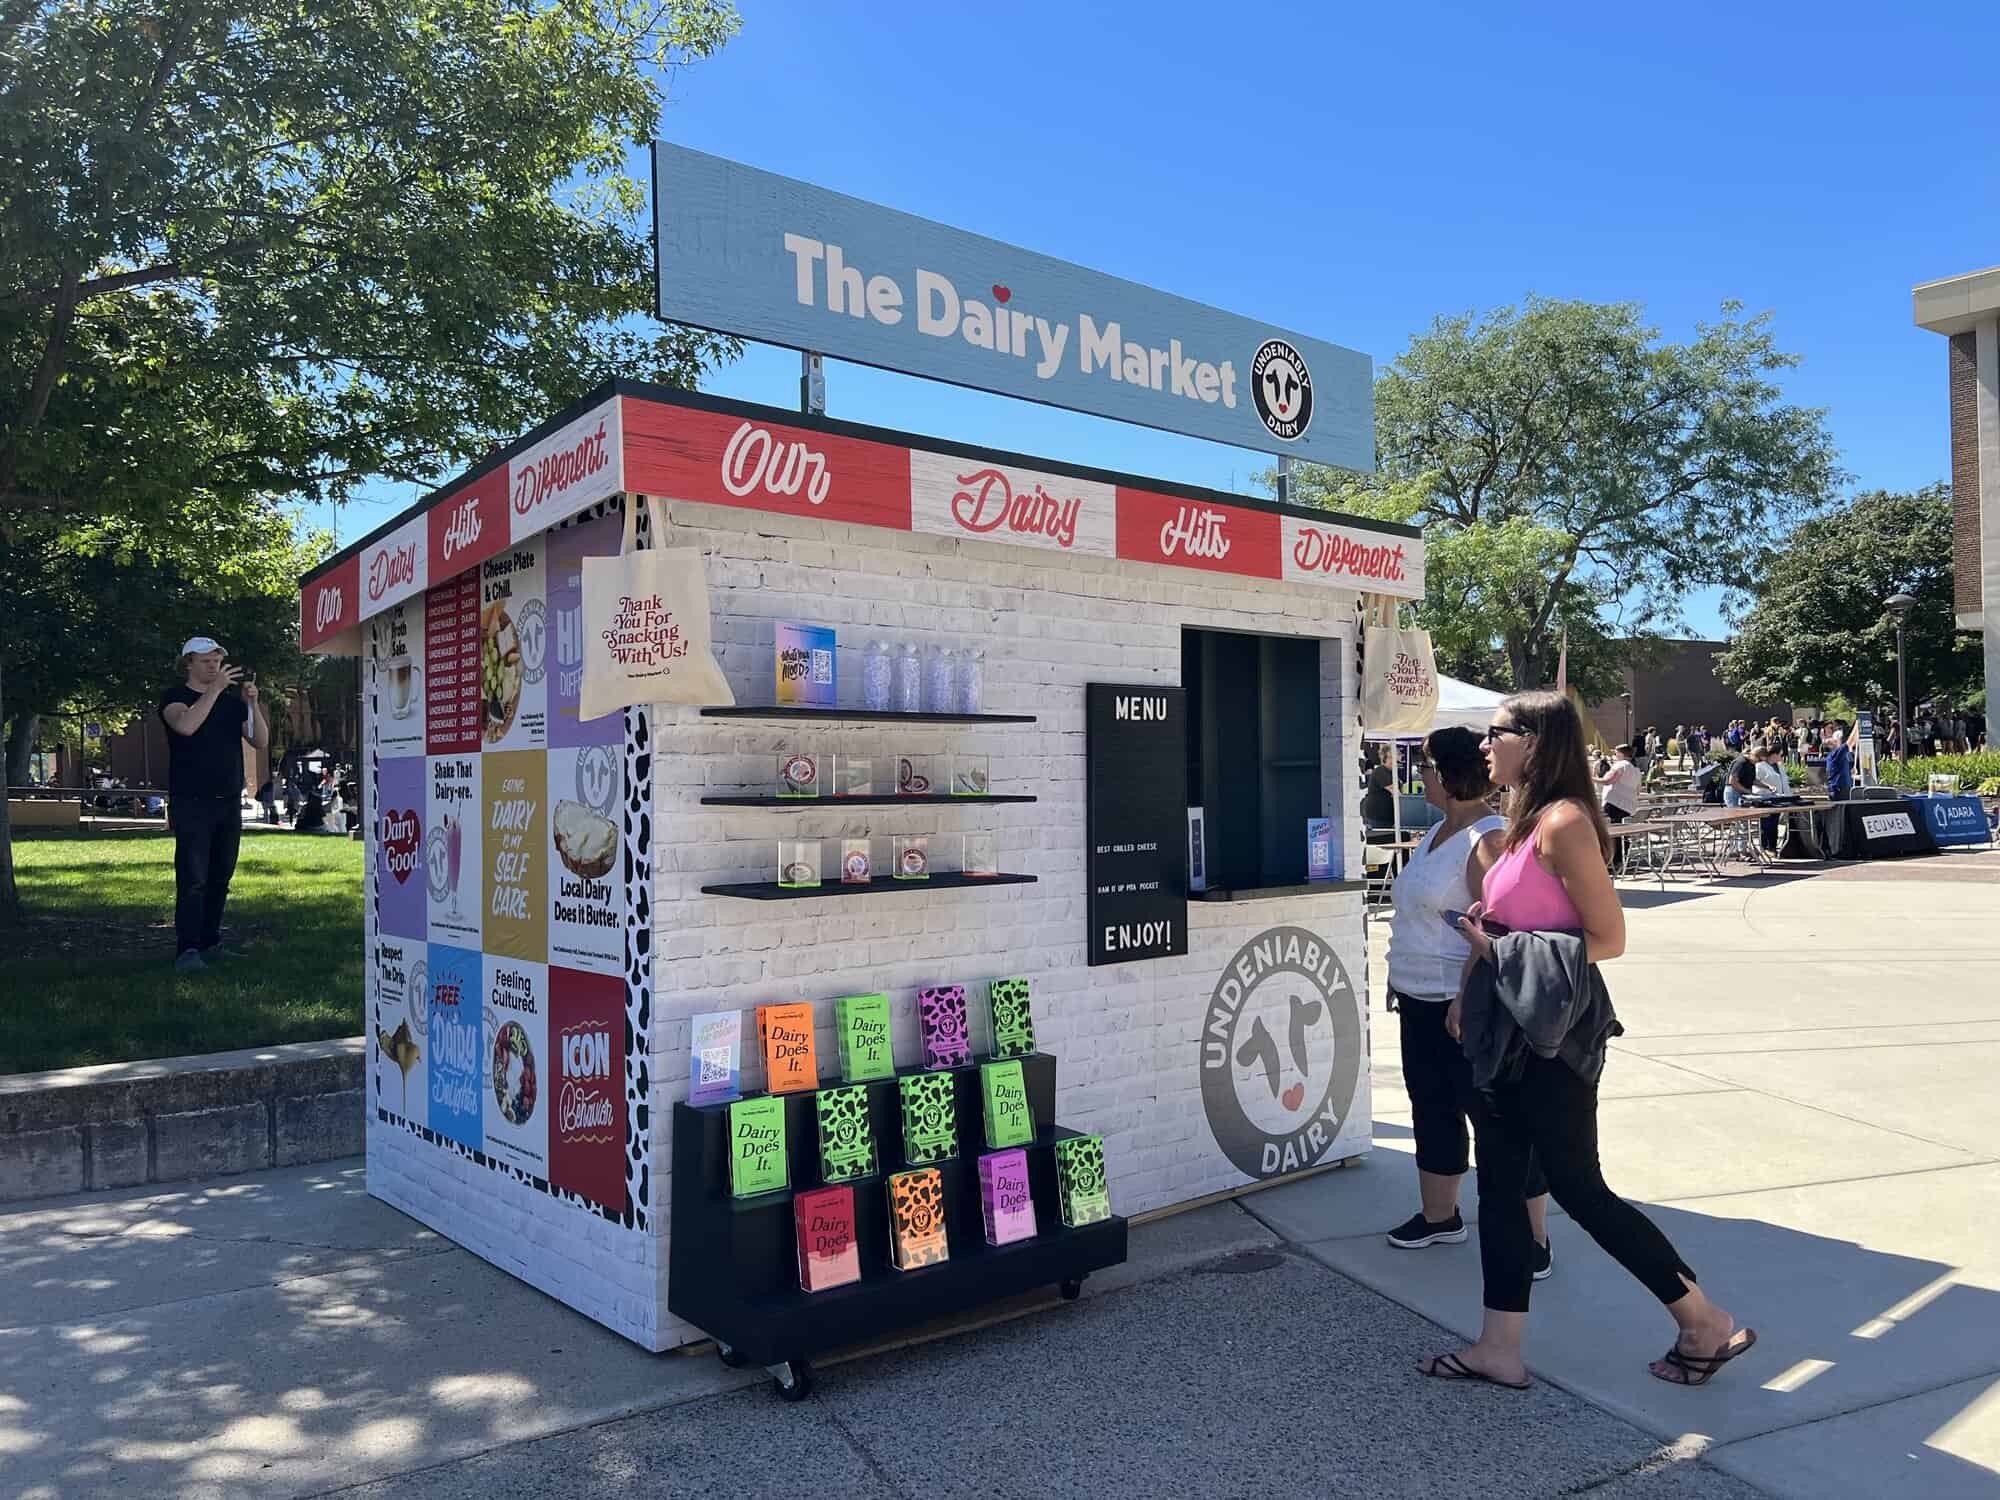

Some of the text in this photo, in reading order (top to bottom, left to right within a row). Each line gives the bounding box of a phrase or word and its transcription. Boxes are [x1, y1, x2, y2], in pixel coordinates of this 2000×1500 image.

[784, 231, 1237, 409] The Dairy Market
[1254, 344, 1310, 389] UNDENIABLY
[1266, 415, 1299, 437] DAIRY
[721, 420, 832, 505] Our
[951, 467, 1081, 549] Dairy
[1160, 505, 1231, 561] Hits
[316, 586, 343, 633] Our
[368, 542, 417, 601] Dairy
[443, 497, 483, 560] Hits
[483, 550, 535, 580] Cheese Plate
[485, 578, 513, 602] & Chill.
[619, 594, 662, 616] Thank
[613, 610, 673, 630] You For
[601, 624, 680, 649] Snacking
[610, 639, 689, 666] With Us!
[1115, 695, 1167, 721] MENU
[434, 760, 473, 780] Shake That
[502, 778, 526, 793] EATING
[491, 800, 536, 832] DAIRY
[1948, 806, 1976, 818] ADARA
[382, 815, 415, 844] Dairy
[1866, 816, 1909, 834] ECUMEN
[385, 841, 422, 873] Good.
[1097, 845, 1111, 854] BEST
[1137, 842, 1158, 851] CHEESE
[494, 852, 530, 883] SELF
[560, 877, 612, 907] Local Dairy
[1117, 884, 1125, 893] UP
[1139, 881, 1159, 891] POCKET
[491, 885, 532, 921] CARE.
[554, 900, 620, 929] Does it Butter.
[1104, 919, 1172, 951] ENJOY!
[381, 943, 403, 964] Respect
[381, 964, 392, 982] The
[495, 969, 531, 998] Feeling
[434, 984, 461, 1007] FREE
[491, 988, 538, 1015] Cultured.
[1205, 935, 1347, 1070] UNDENIABLY
[771, 1026, 808, 1045] Dairy
[852, 1017, 886, 1035] Dairy
[775, 1043, 809, 1059] Does
[855, 1034, 886, 1049] Does
[561, 1031, 610, 1078] ICON
[788, 1058, 803, 1072] It.
[867, 1047, 880, 1061] It.
[995, 1084, 1024, 1102] Dairy
[559, 1080, 614, 1134] Behavior
[999, 1100, 1025, 1116] Does
[1010, 1111, 1022, 1127] It.
[736, 1123, 780, 1142] Dairy
[1260, 1097, 1339, 1174] DAIRY
[742, 1139, 780, 1159] Does
[755, 1156, 772, 1171] It.
